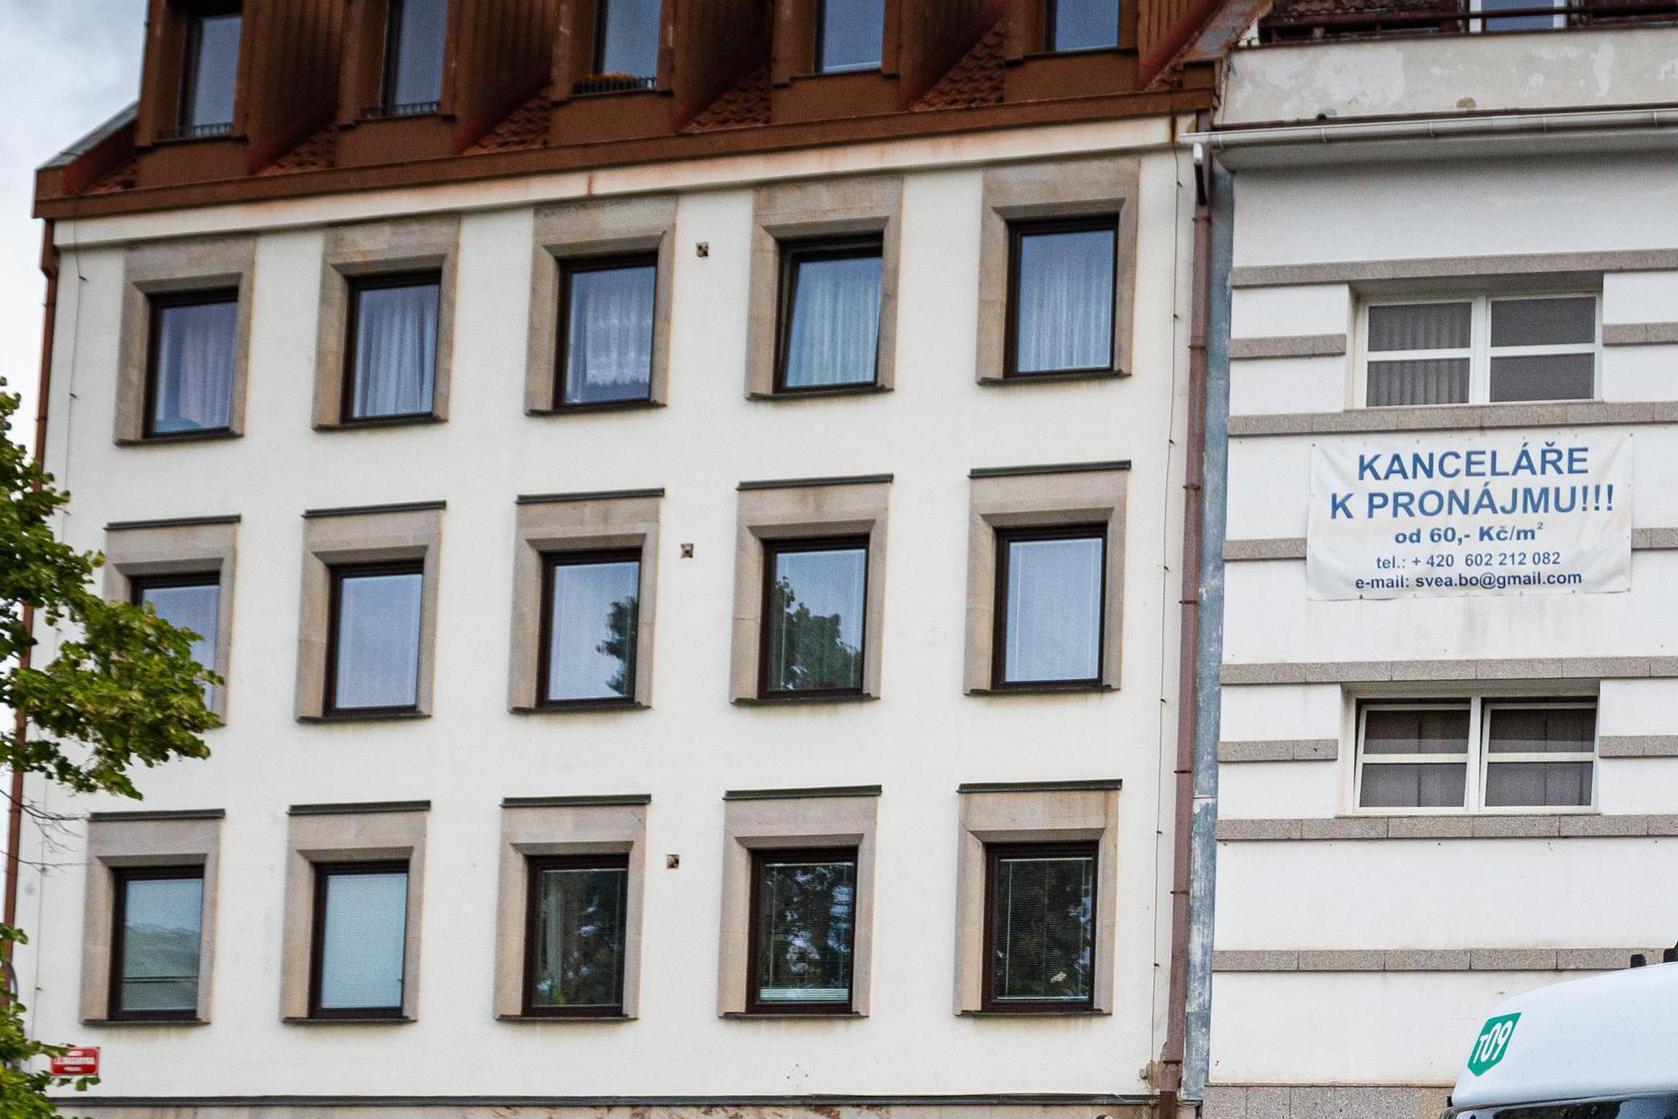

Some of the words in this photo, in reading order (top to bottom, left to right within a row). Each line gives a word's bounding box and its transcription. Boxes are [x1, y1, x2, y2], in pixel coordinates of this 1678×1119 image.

[1358, 441, 1589, 481] KANCELÁŘE
[1330, 492, 1355, 519] K
[1367, 482, 1614, 519] PRONÁJMU!!!
[1394, 527, 1421, 544] od
[1429, 526, 1471, 546] 60,-
[1376, 555, 1406, 569] tel.:
[1411, 557, 1422, 567] +
[1426, 554, 1455, 568] 420
[1465, 553, 1493, 567] 602
[1498, 552, 1529, 566] 212
[1532, 551, 1561, 566] 082
[1355, 574, 1410, 590] e-mail:
[1415, 571, 1582, 590] svea.bo@gmail.com
[1473, 1020, 1513, 1064] T09
